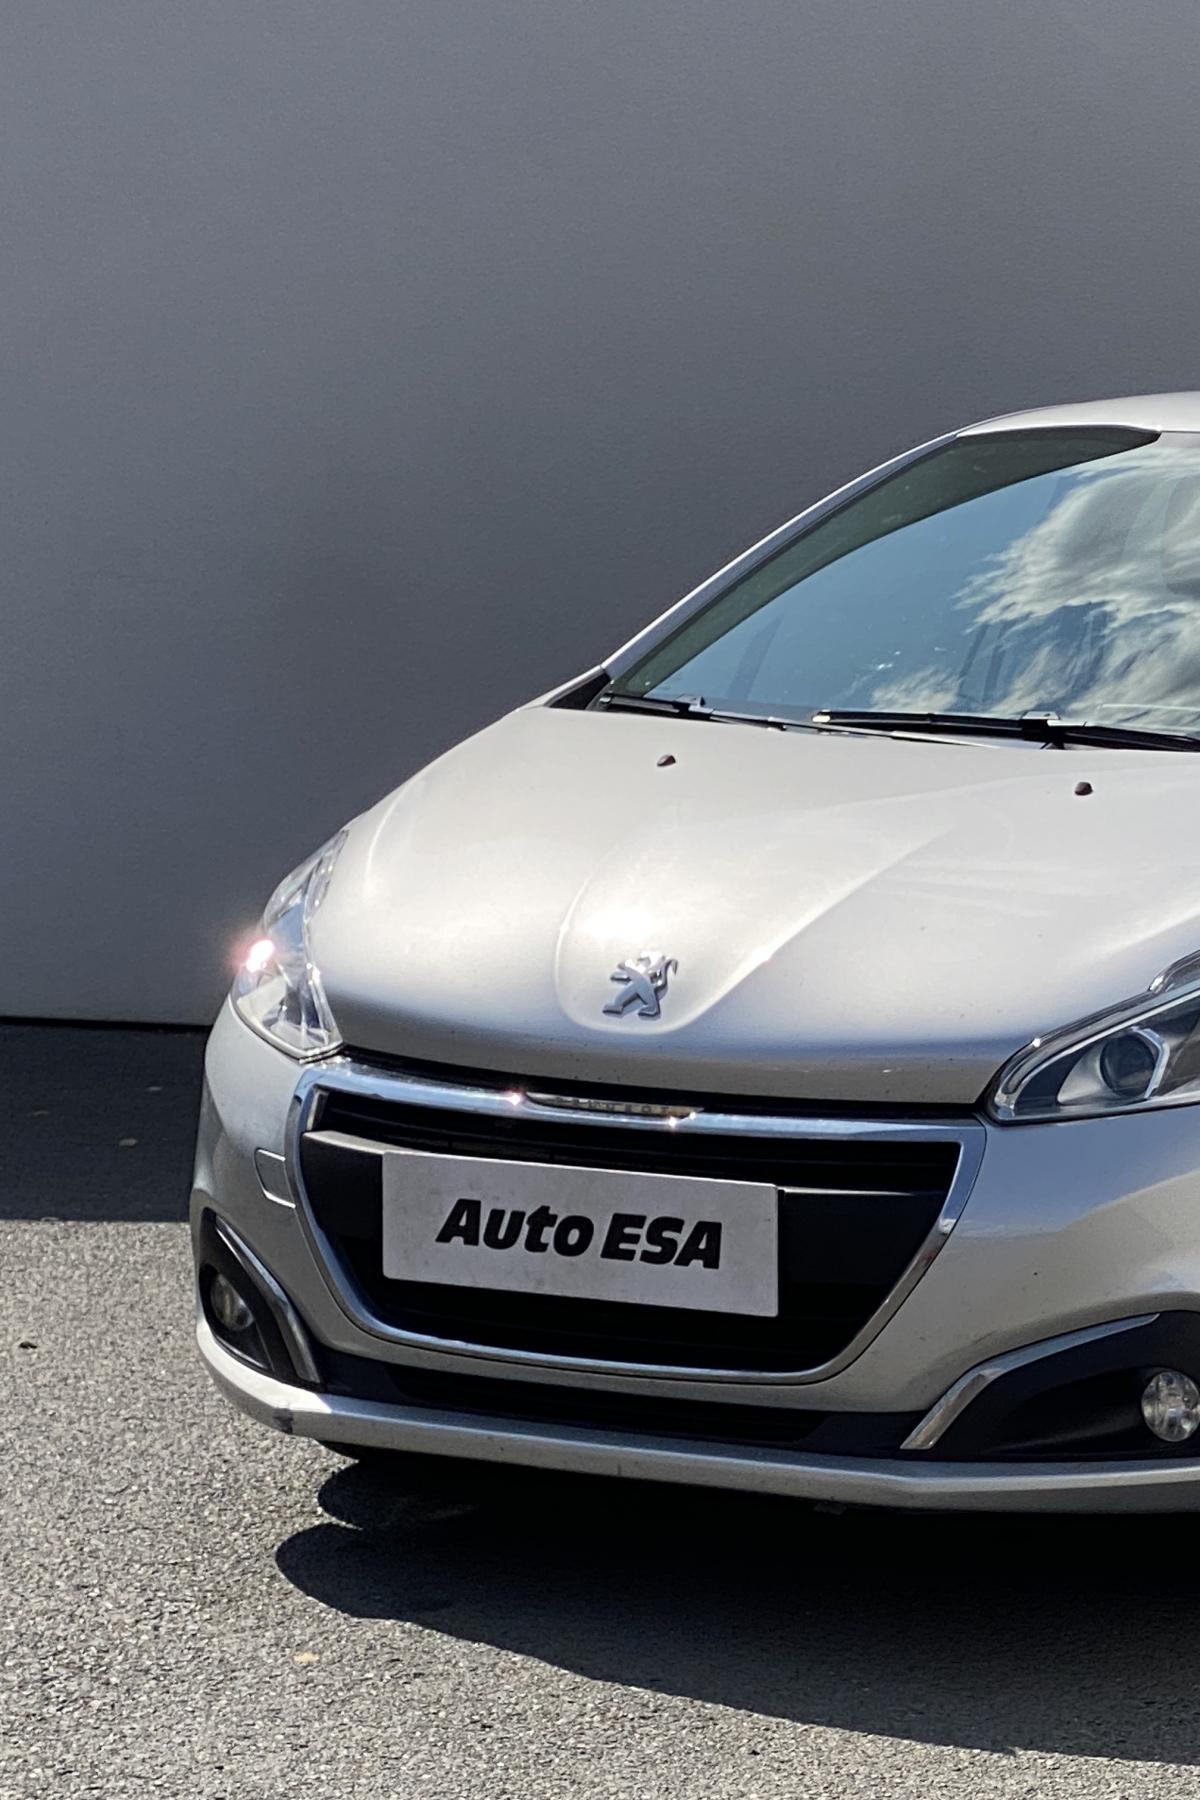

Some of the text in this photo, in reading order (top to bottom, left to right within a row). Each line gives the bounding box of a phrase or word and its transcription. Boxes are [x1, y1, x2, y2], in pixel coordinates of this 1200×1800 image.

[555, 1096, 670, 1115] UEOT
[435, 1198, 722, 1269] Auto ESA
